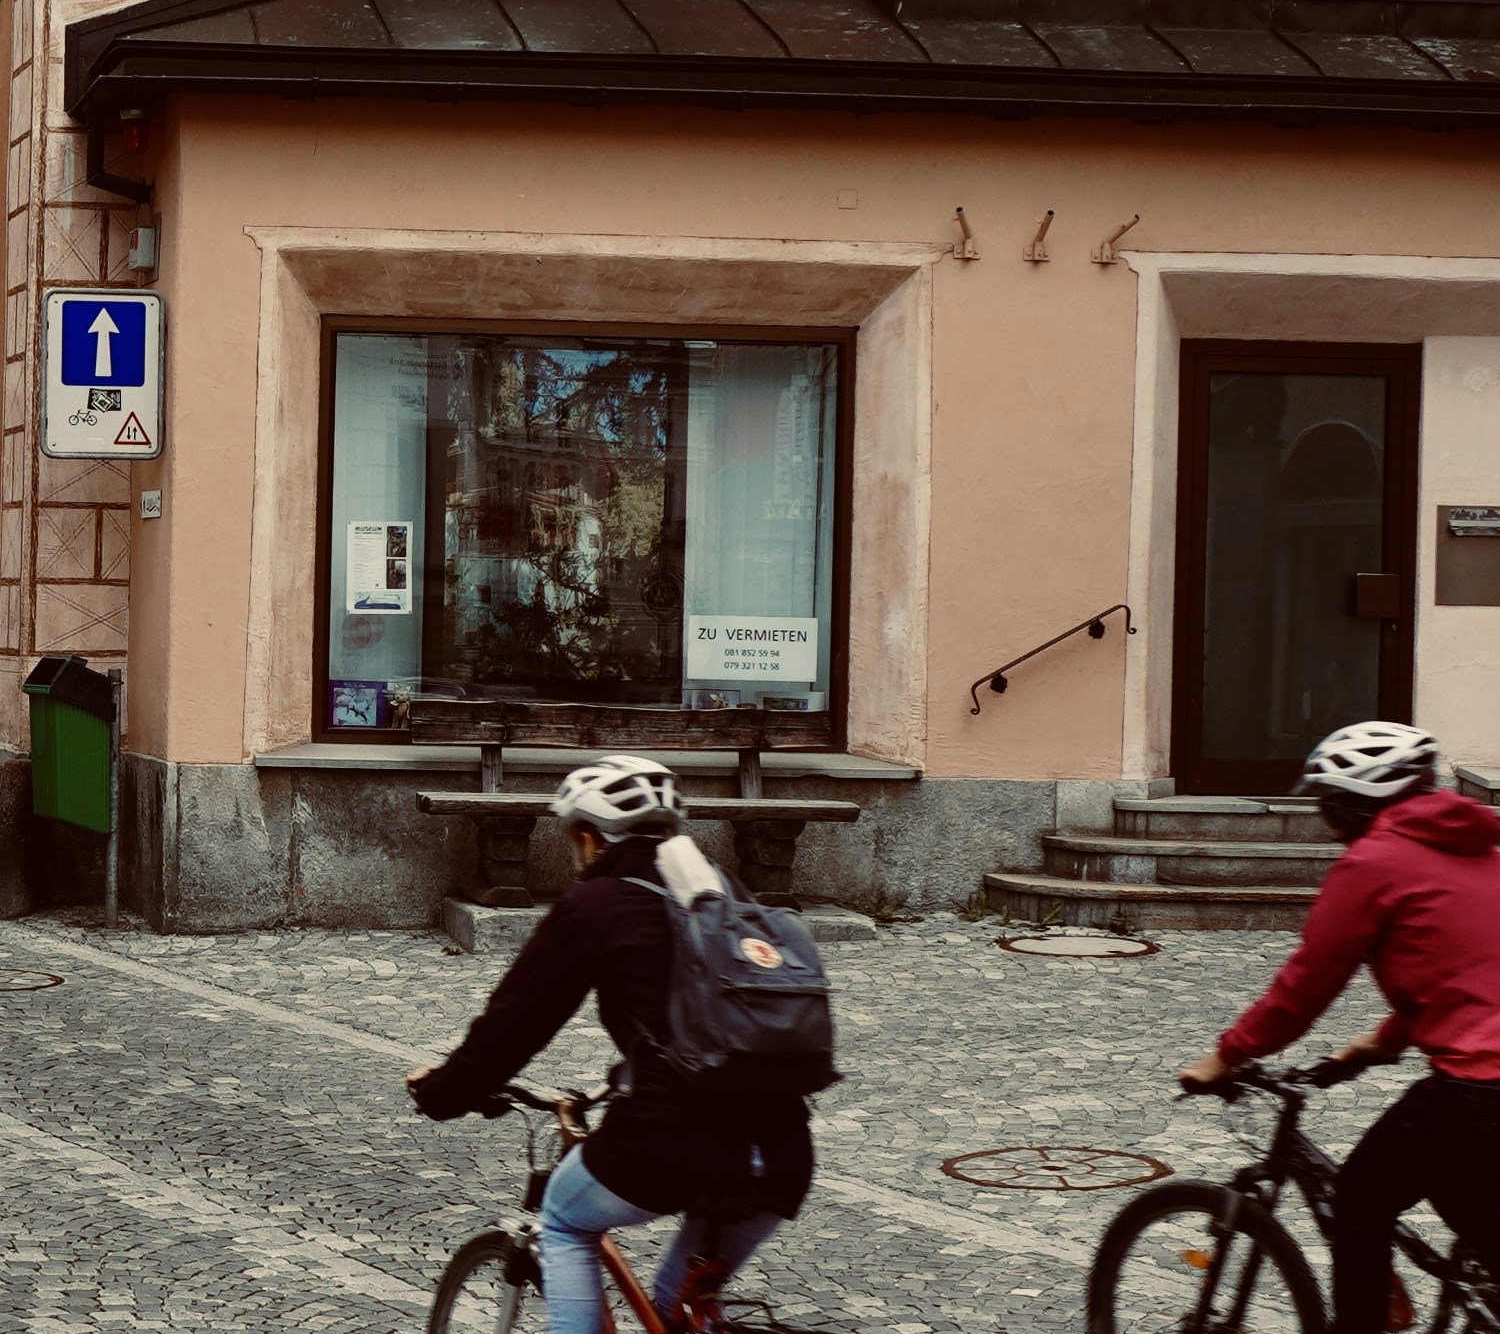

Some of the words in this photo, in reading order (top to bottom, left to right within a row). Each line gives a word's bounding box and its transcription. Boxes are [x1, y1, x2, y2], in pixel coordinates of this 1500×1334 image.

[697, 627, 717, 641] ZU
[725, 628, 808, 643] VERMIETEN
[724, 648, 739, 657] 081
[741, 648, 756, 657] 852
[723, 661, 739, 670] 079
[741, 662, 756, 670] 321
[758, 662, 768, 670] 12
